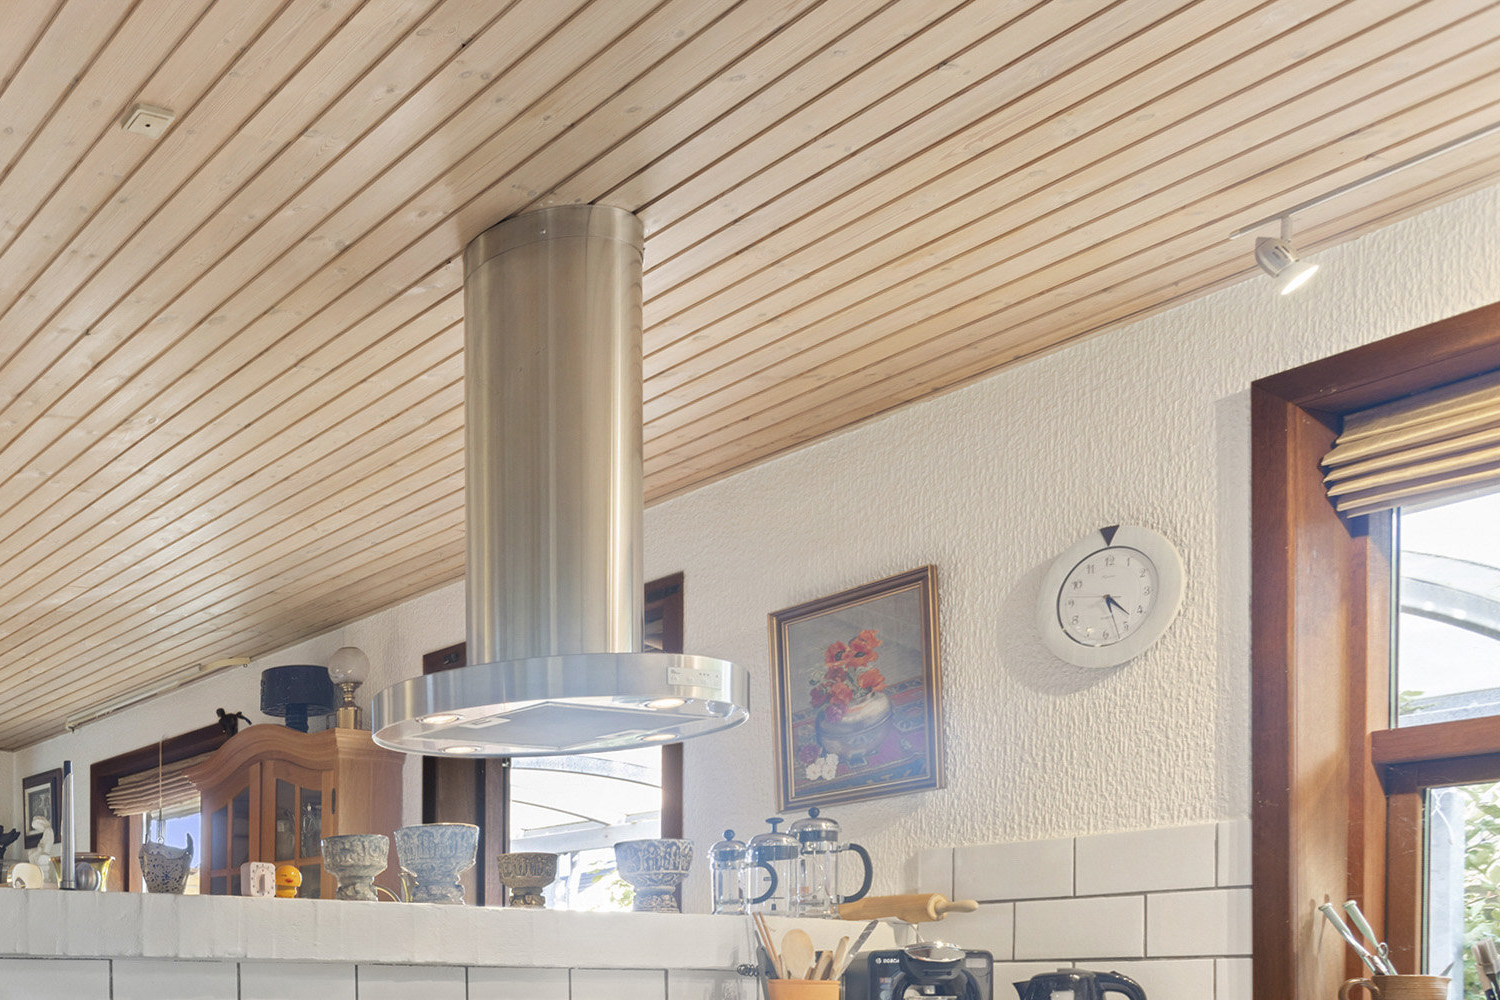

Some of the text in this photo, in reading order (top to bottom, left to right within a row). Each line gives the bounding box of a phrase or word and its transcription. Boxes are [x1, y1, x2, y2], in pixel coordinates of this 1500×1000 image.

[1104, 556, 1115, 566] 12
[1087, 565, 1095, 574] 11
[1140, 568, 1146, 578] 2
[1072, 581, 1083, 590] 10
